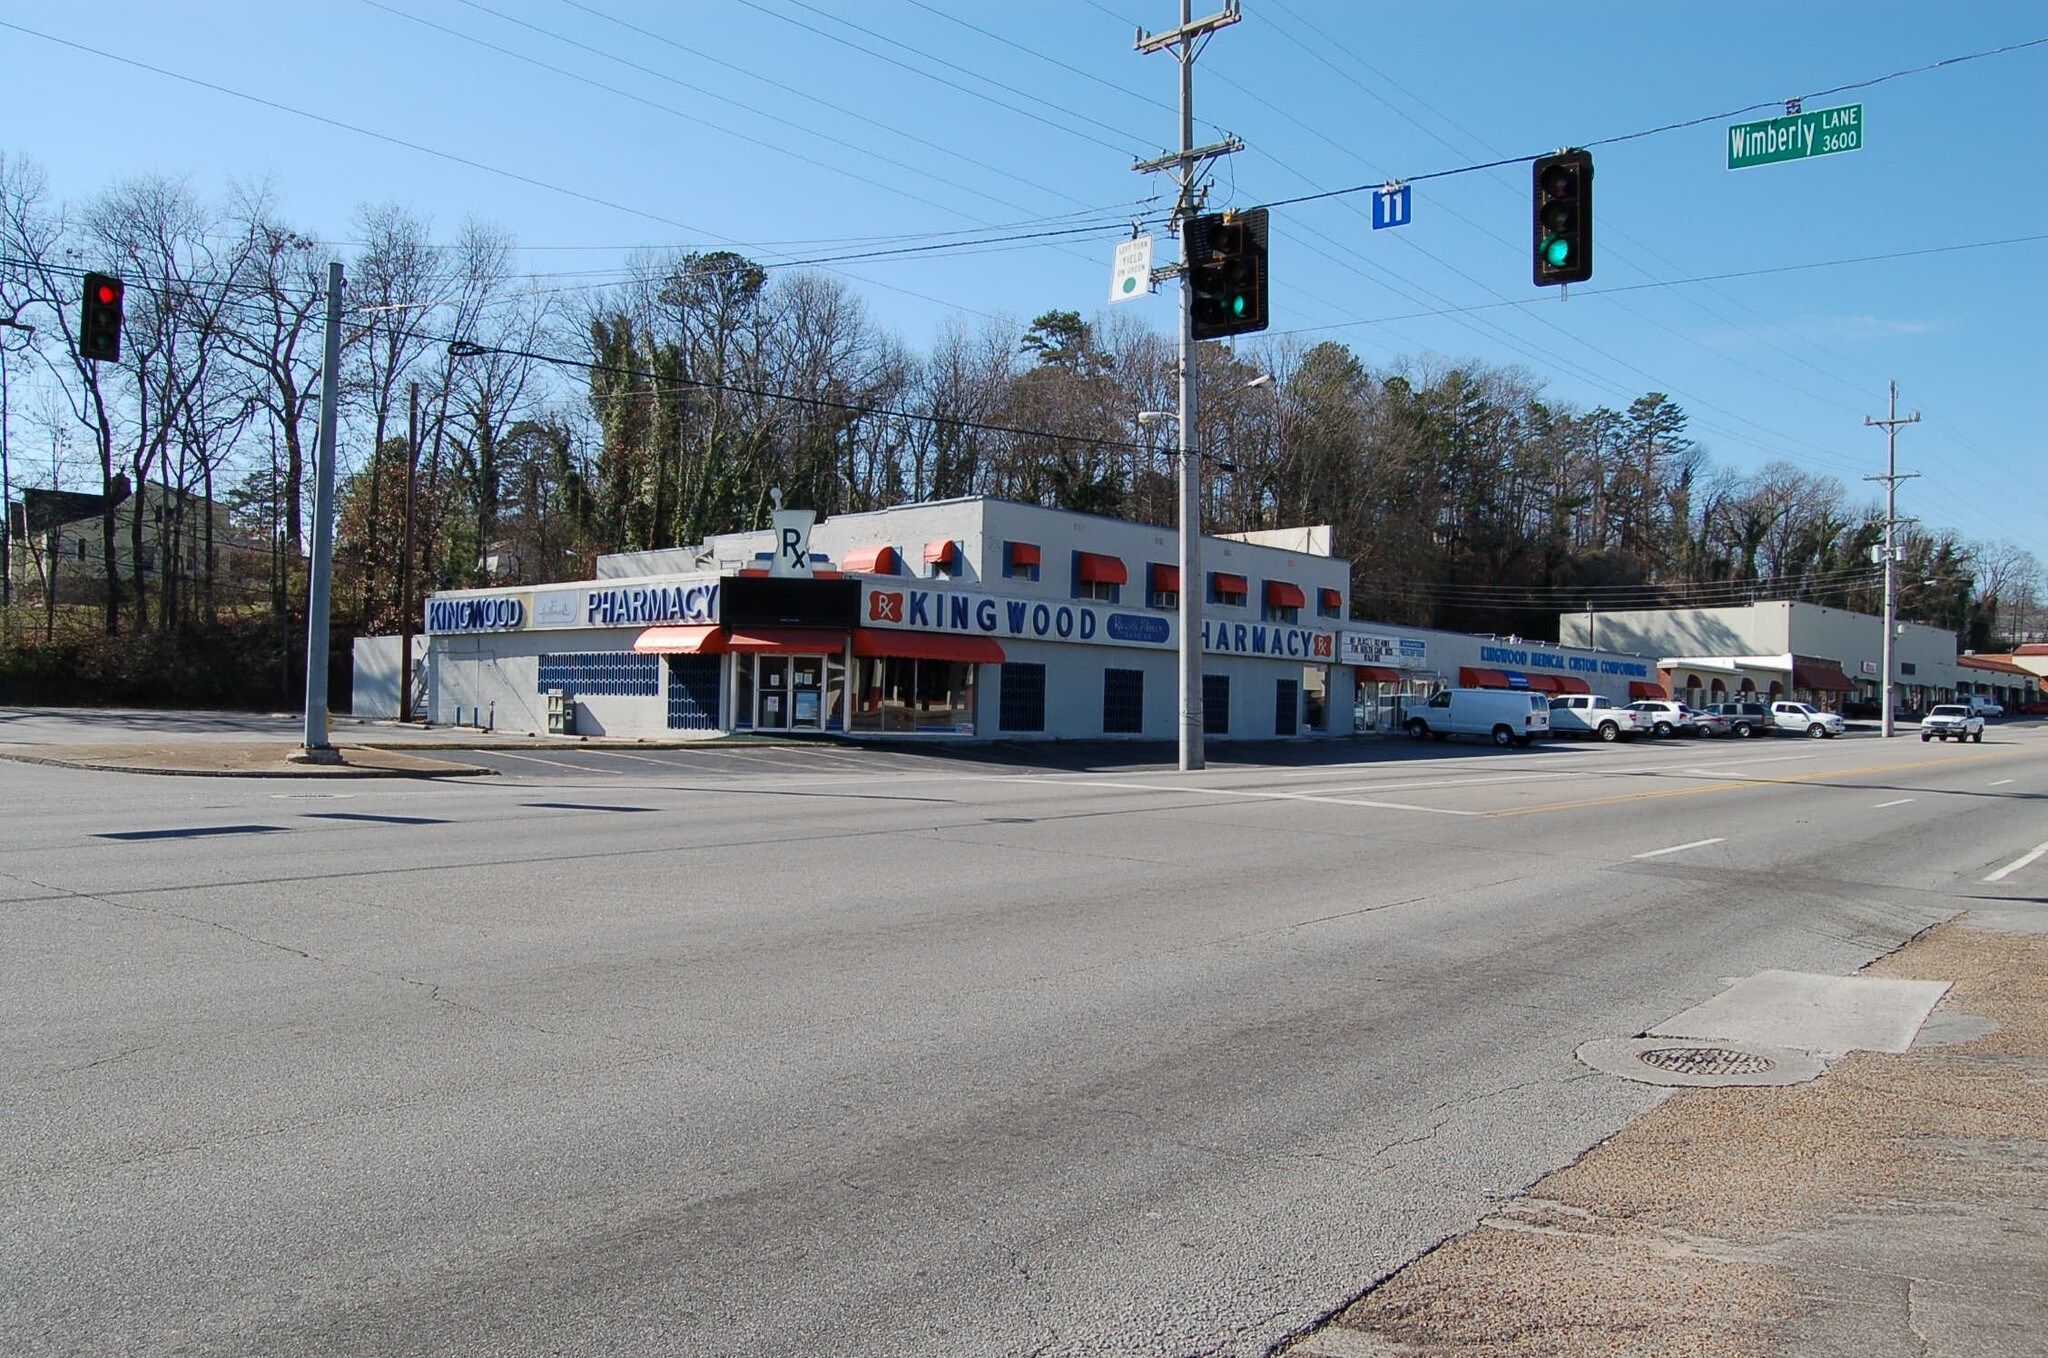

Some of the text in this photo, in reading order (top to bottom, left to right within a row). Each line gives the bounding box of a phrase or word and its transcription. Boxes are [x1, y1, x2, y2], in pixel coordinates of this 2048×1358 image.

[1731, 107, 1858, 159] Wimberly LANE
[1822, 130, 1857, 152] 3600
[1381, 192, 1402, 223] 11
[1122, 252, 1143, 266] YIELD
[783, 528, 807, 569] Rx
[430, 598, 523, 630] KINGWOOD
[588, 583, 720, 624] PHARMACY
[909, 590, 1096, 640] KINGWOOD
[1201, 621, 1313, 657] HARMACY
[1480, 646, 1528, 666] KINGWOOD
[1531, 652, 1565, 670] MEDICAL
[1568, 656, 1598, 673] CUSTOM
